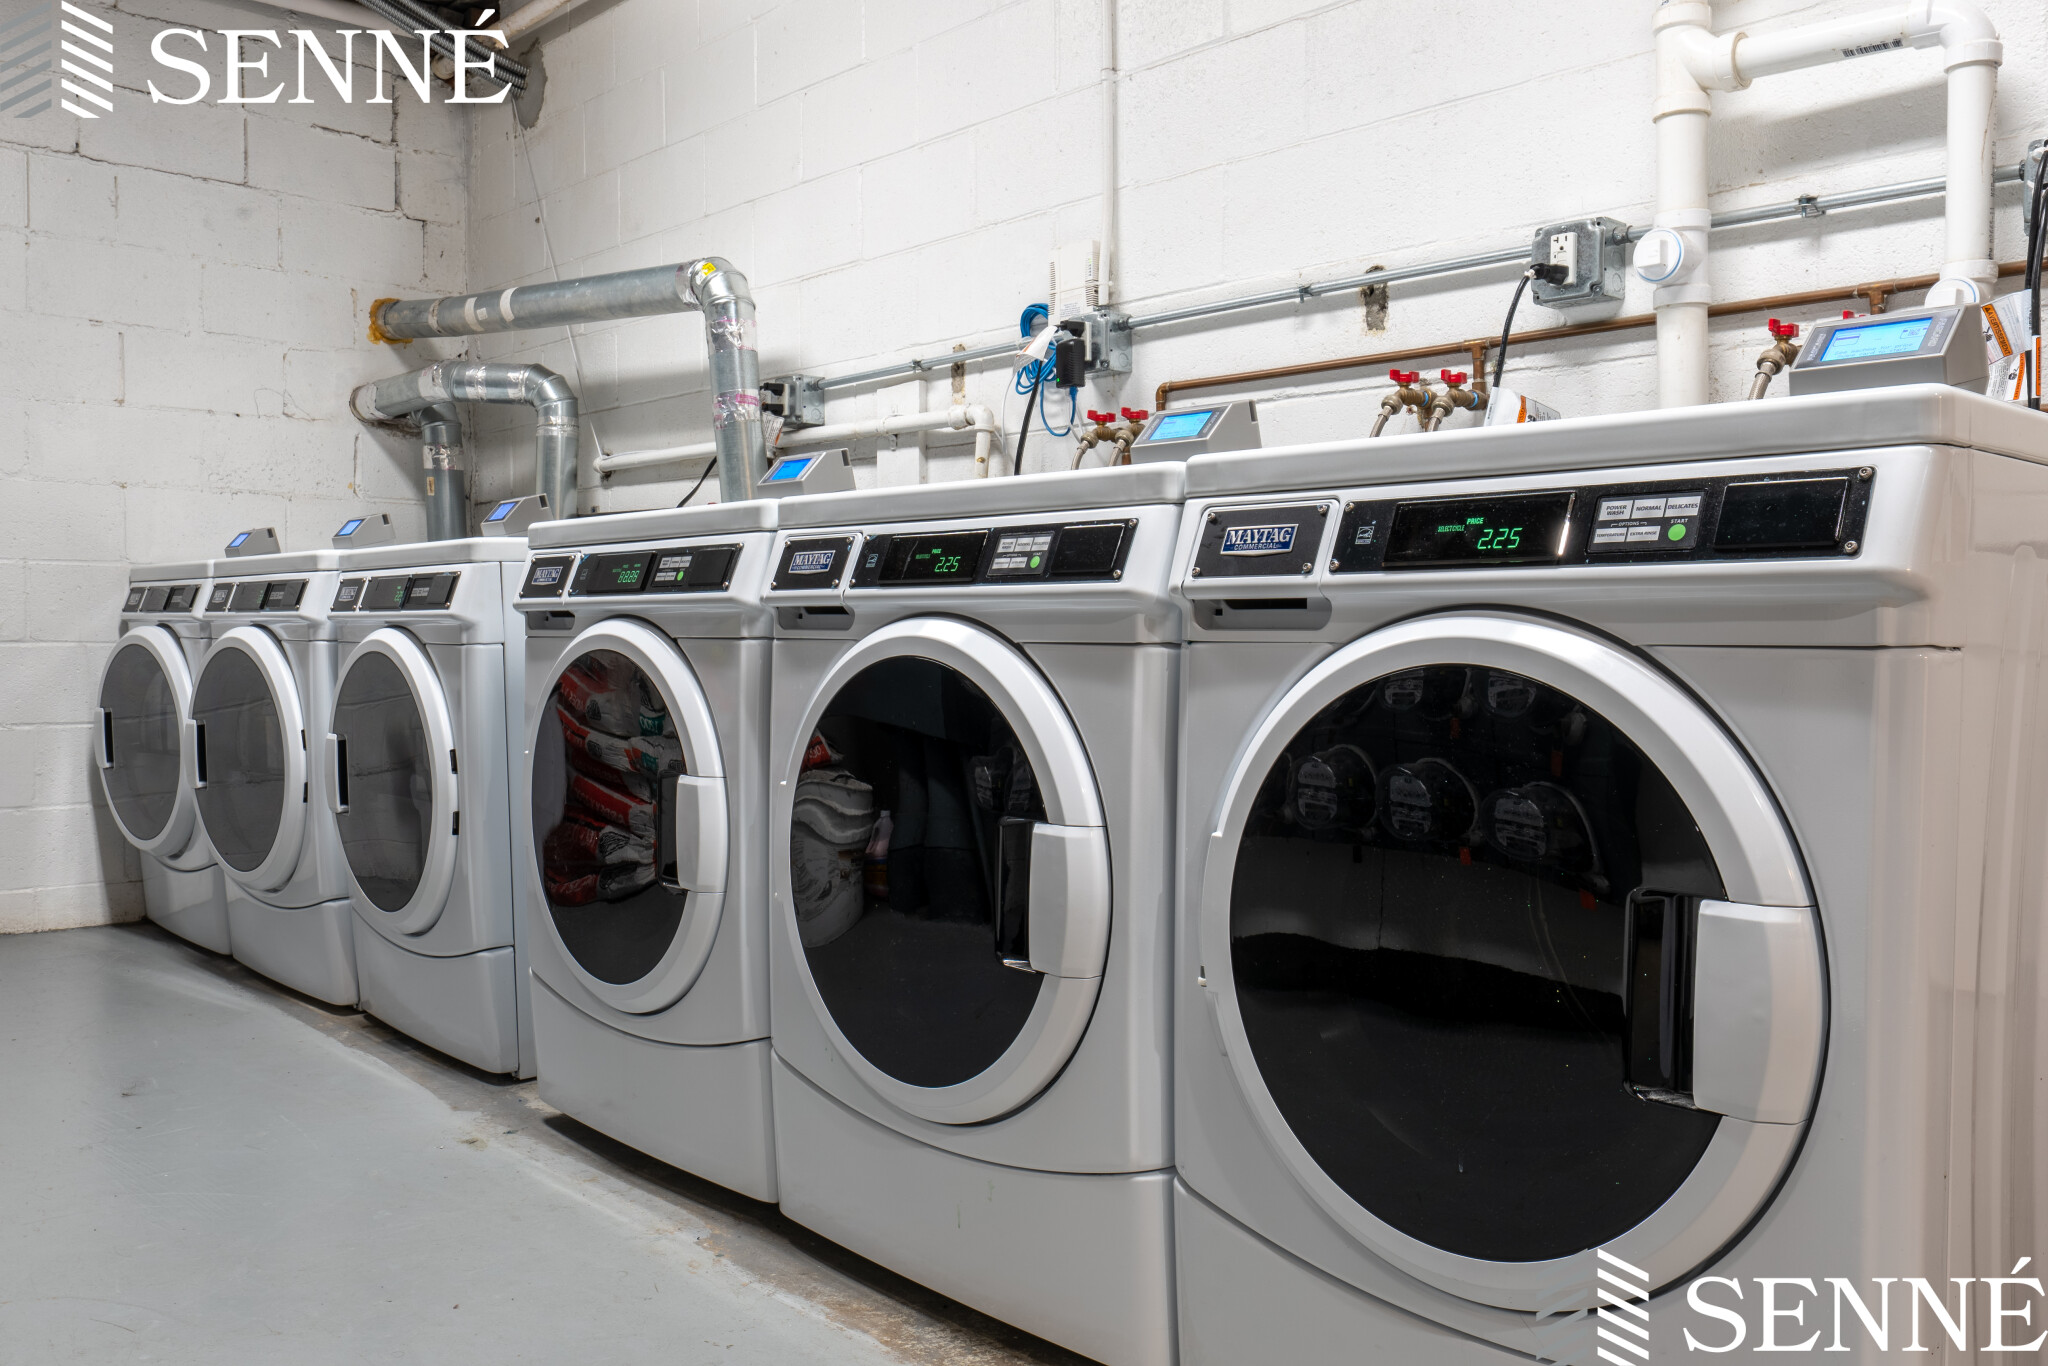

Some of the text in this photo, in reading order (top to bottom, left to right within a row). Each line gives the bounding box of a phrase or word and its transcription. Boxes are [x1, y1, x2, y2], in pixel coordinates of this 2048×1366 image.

[1987, 310, 2011, 356] AVERTISSEMENT
[1466, 517, 1484, 525] PRICE
[1226, 527, 1292, 546] MAYTAG
[1477, 528, 1523, 549] 2.25
[1233, 542, 1277, 551] COMMERCIAL
[793, 553, 831, 566] MAYTAG
[934, 556, 961, 572] 2.25
